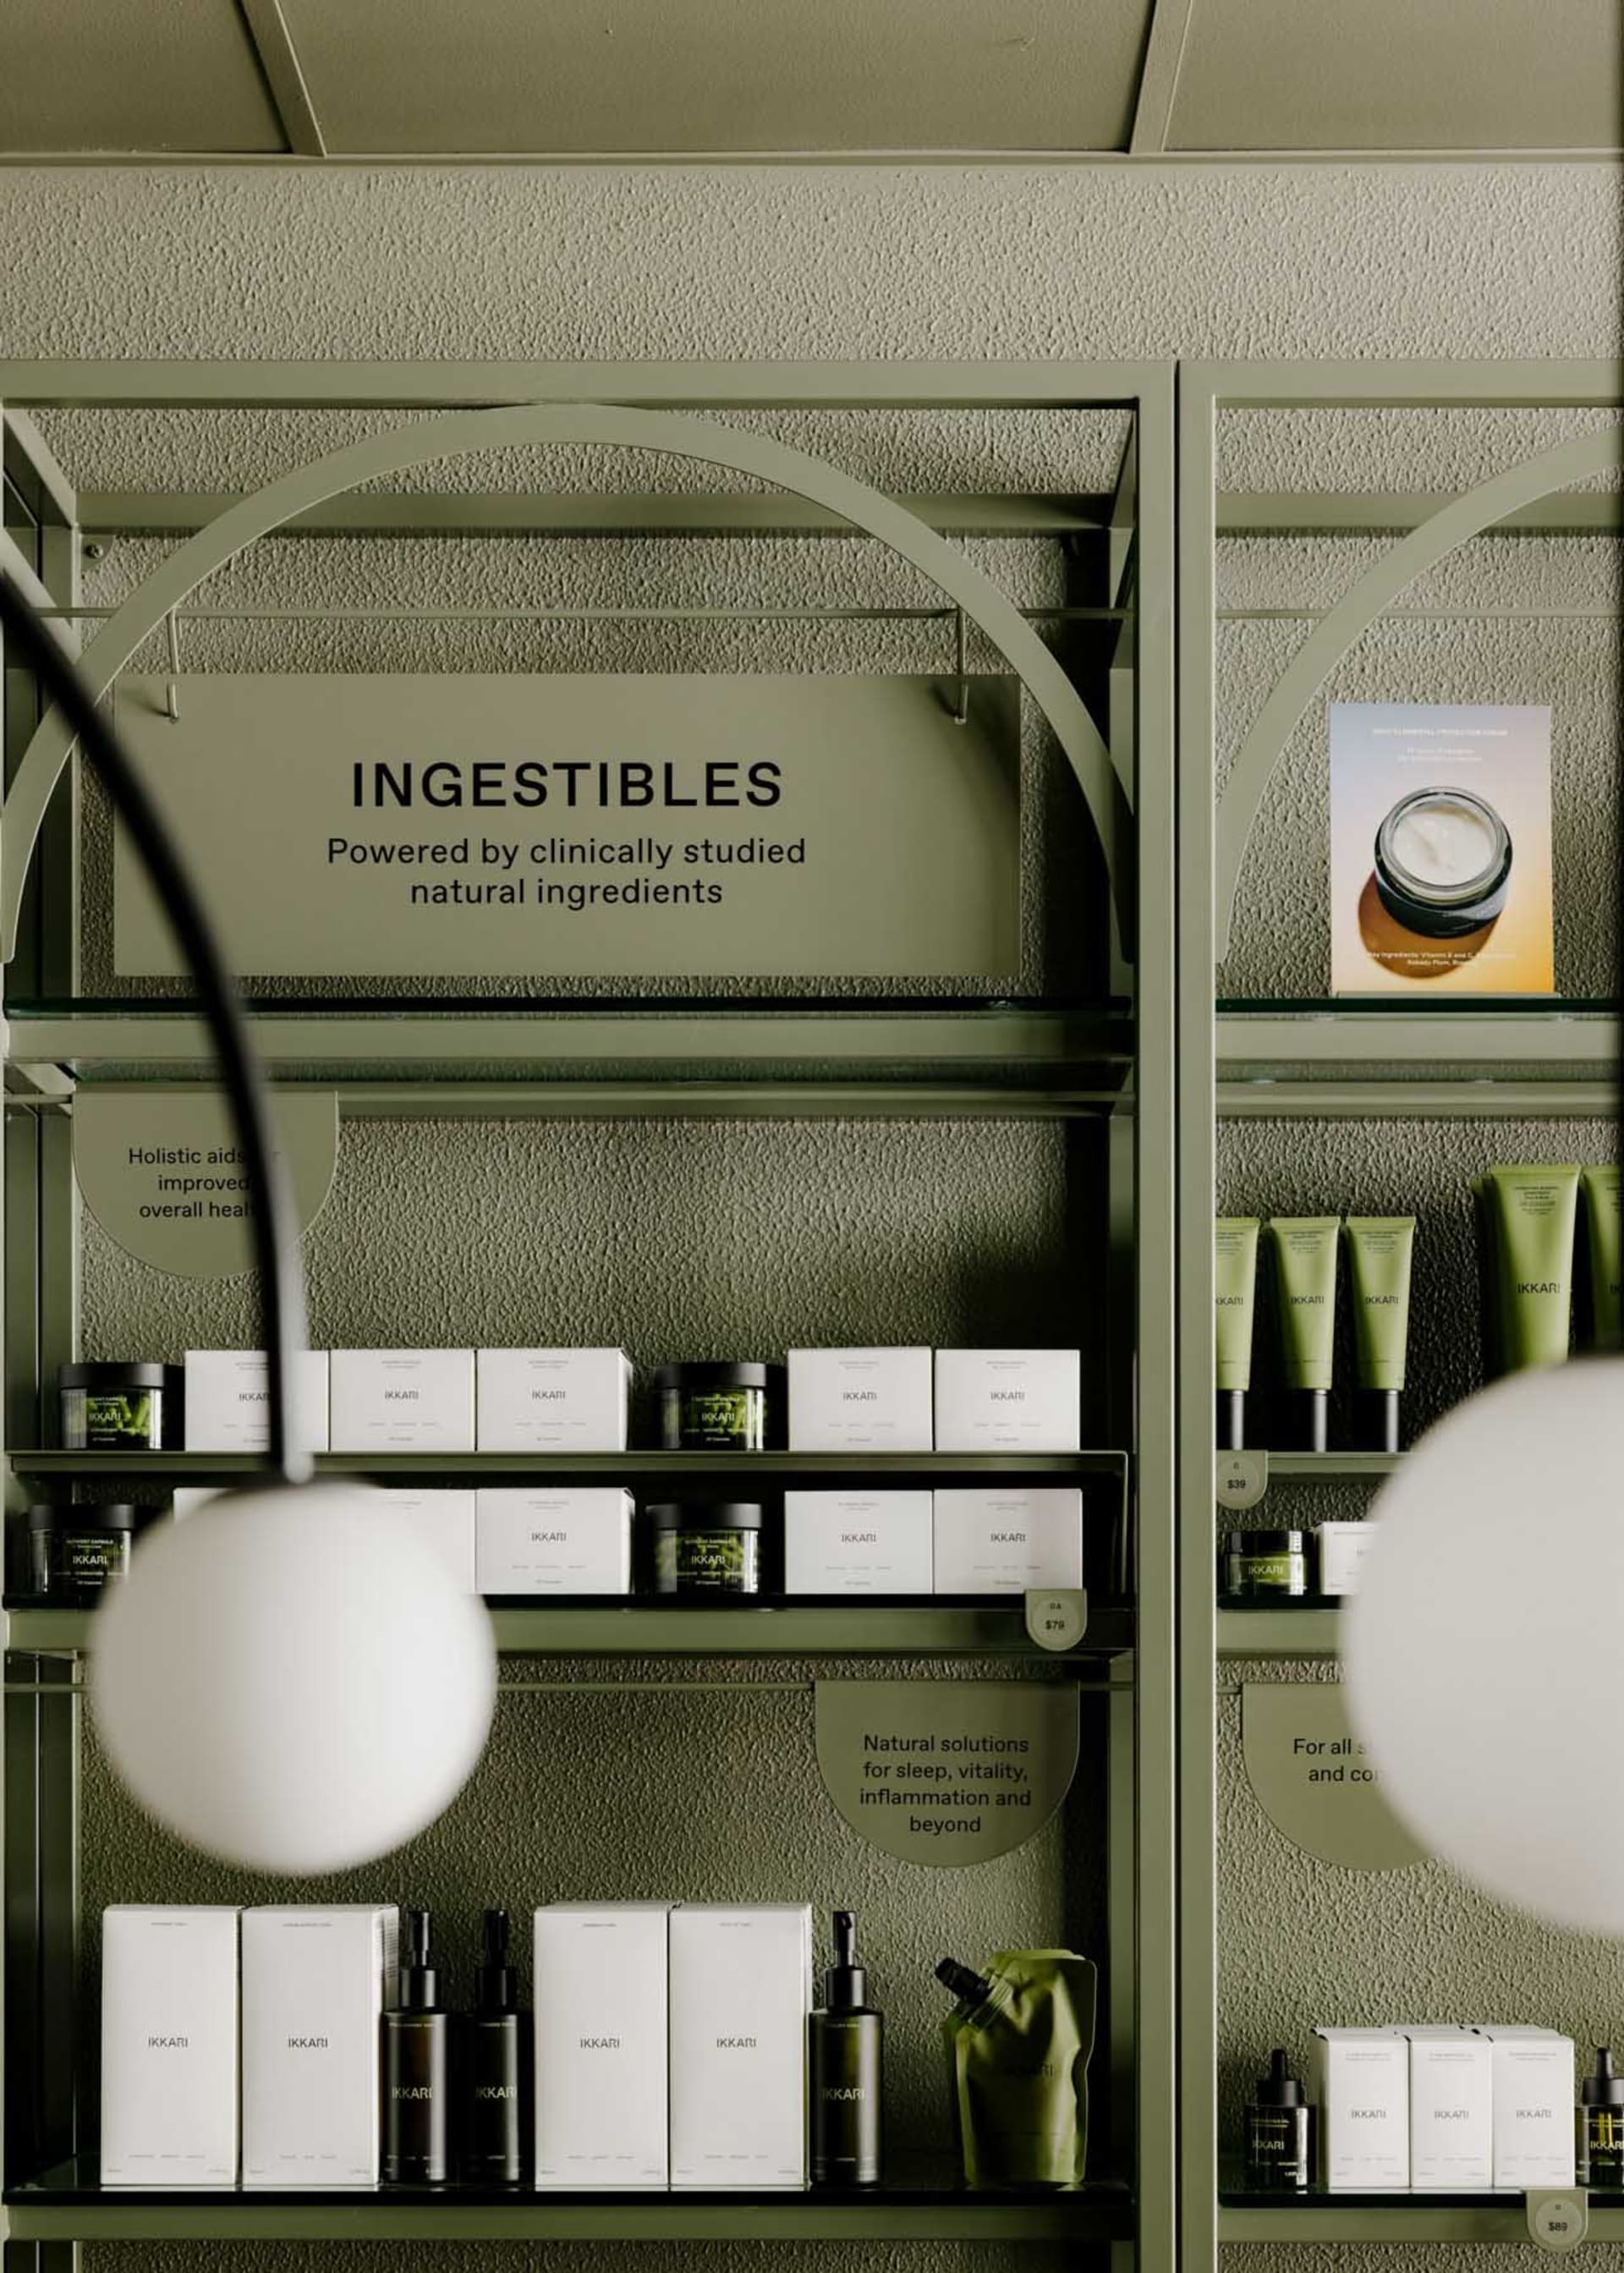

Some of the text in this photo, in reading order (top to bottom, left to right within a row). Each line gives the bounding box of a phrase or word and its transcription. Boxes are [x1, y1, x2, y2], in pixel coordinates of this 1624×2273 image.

[353, 761, 782, 808] INGESTIBLES
[328, 838, 807, 869] Powered by clinically studied
[411, 879, 723, 911] natural ingredients
[129, 1147, 245, 1165] Holistic aids
[139, 1201, 255, 1218] overall heal
[1517, 1282, 1561, 1293] IKKARI
[1215, 1296, 1243, 1305] KKARI
[1291, 1295, 1324, 1304] IKKARI
[1365, 1295, 1399, 1304] IKKARI
[239, 1392, 271, 1402] IKKAR
[384, 1390, 420, 1400] IKKARI
[531, 1390, 566, 1400] IKKARI
[842, 1392, 877, 1401] IKKARI
[990, 1392, 1025, 1401] IKKARI
[531, 1532, 567, 1542] IKKARI
[841, 1533, 877, 1543] IKKARI
[990, 1533, 1026, 1543] IKKARI
[73, 1555, 107, 1564] IKKARI
[691, 1555, 726, 1564] IKKARI
[1248, 1565, 1284, 1575] IKKARI
[863, 1734, 1029, 1753] Natural solutions
[1293, 1738, 1326, 1755] For
[1330, 1738, 1352, 1755] all
[863, 1761, 1028, 1782] for sleep, vitality,
[1308, 1765, 1345, 1782] and
[859, 1787, 1032, 1806] inflammation and
[909, 1816, 981, 1837] beyond
[147, 2037, 189, 2049] IKKARI
[288, 2037, 329, 2049] IKKARI
[579, 2038, 621, 2050] IKKARI
[716, 2038, 758, 2049] IKKARI
[392, 2086, 433, 2099] IKKARI
